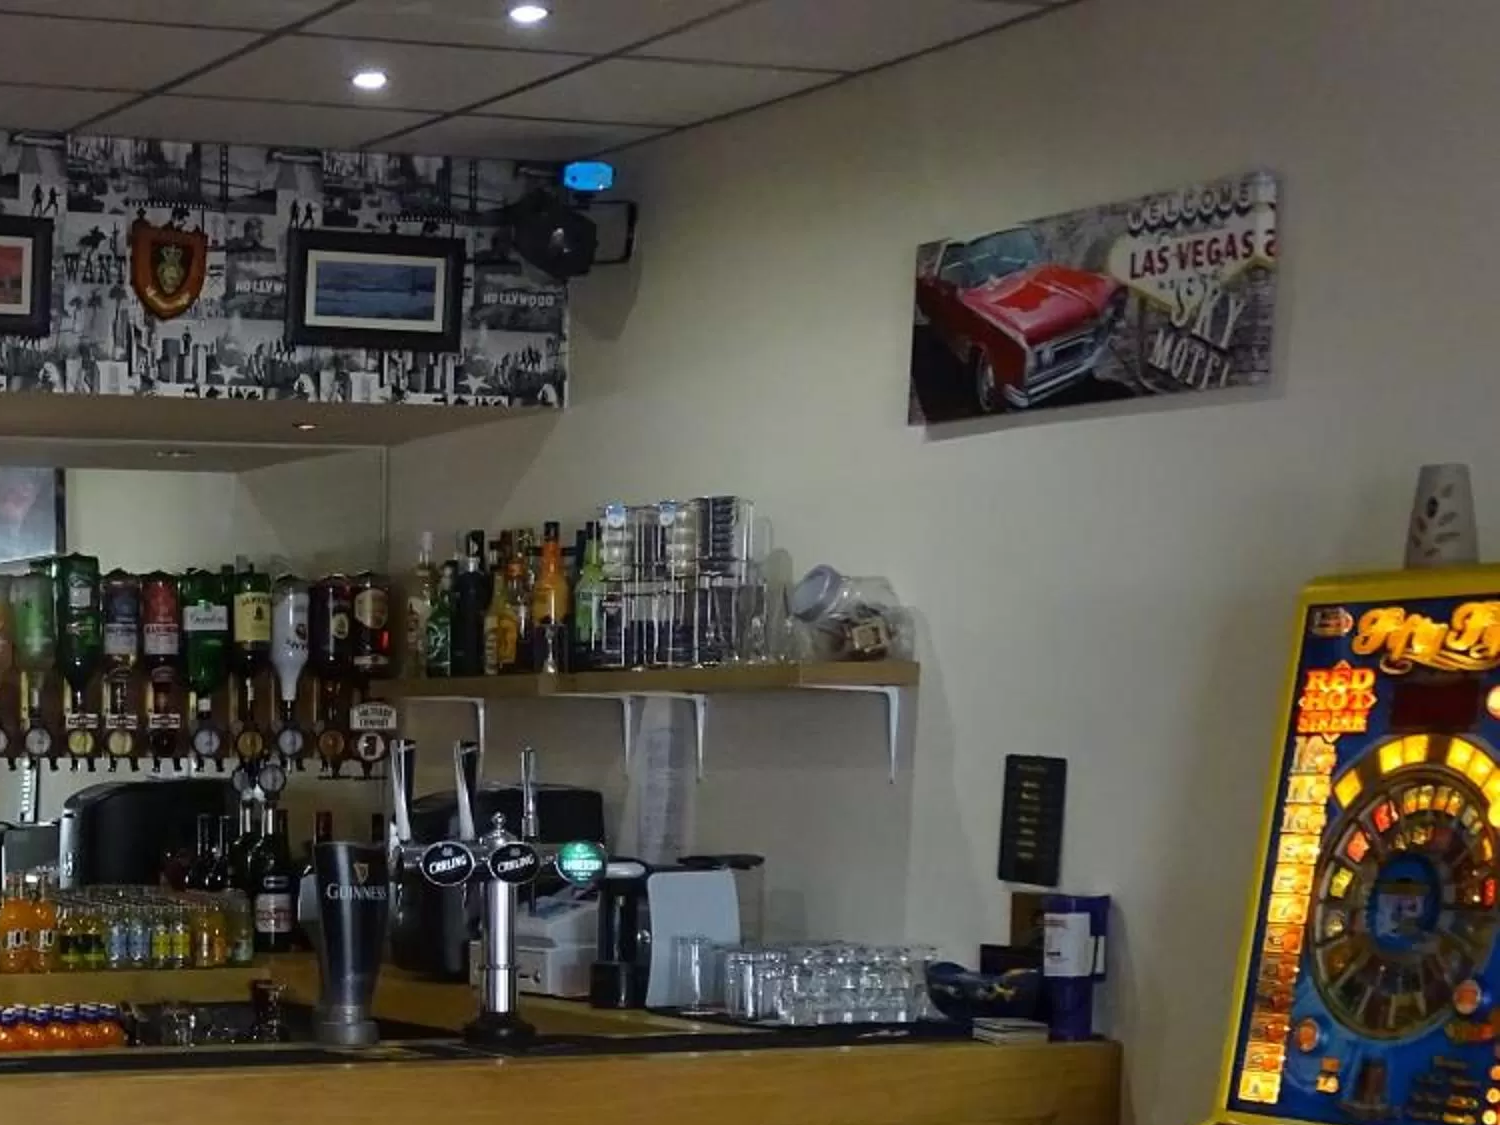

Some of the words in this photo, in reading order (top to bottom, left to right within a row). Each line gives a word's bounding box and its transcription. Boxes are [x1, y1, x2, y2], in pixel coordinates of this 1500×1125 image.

[1129, 250, 1169, 280] LAS
[1174, 228, 1254, 270] VEGAS
[63, 254, 127, 285] WANT
[235, 280, 286, 298] HOLLYW
[482, 291, 556, 309] HOLLYWOOD
[1171, 276, 1245, 349] SKY
[1306, 668, 1376, 690] RED
[1303, 690, 1372, 711] HOT
[428, 854, 468, 876] CARLING
[496, 852, 535, 874] CARLING
[325, 882, 388, 901] GUINNESS
